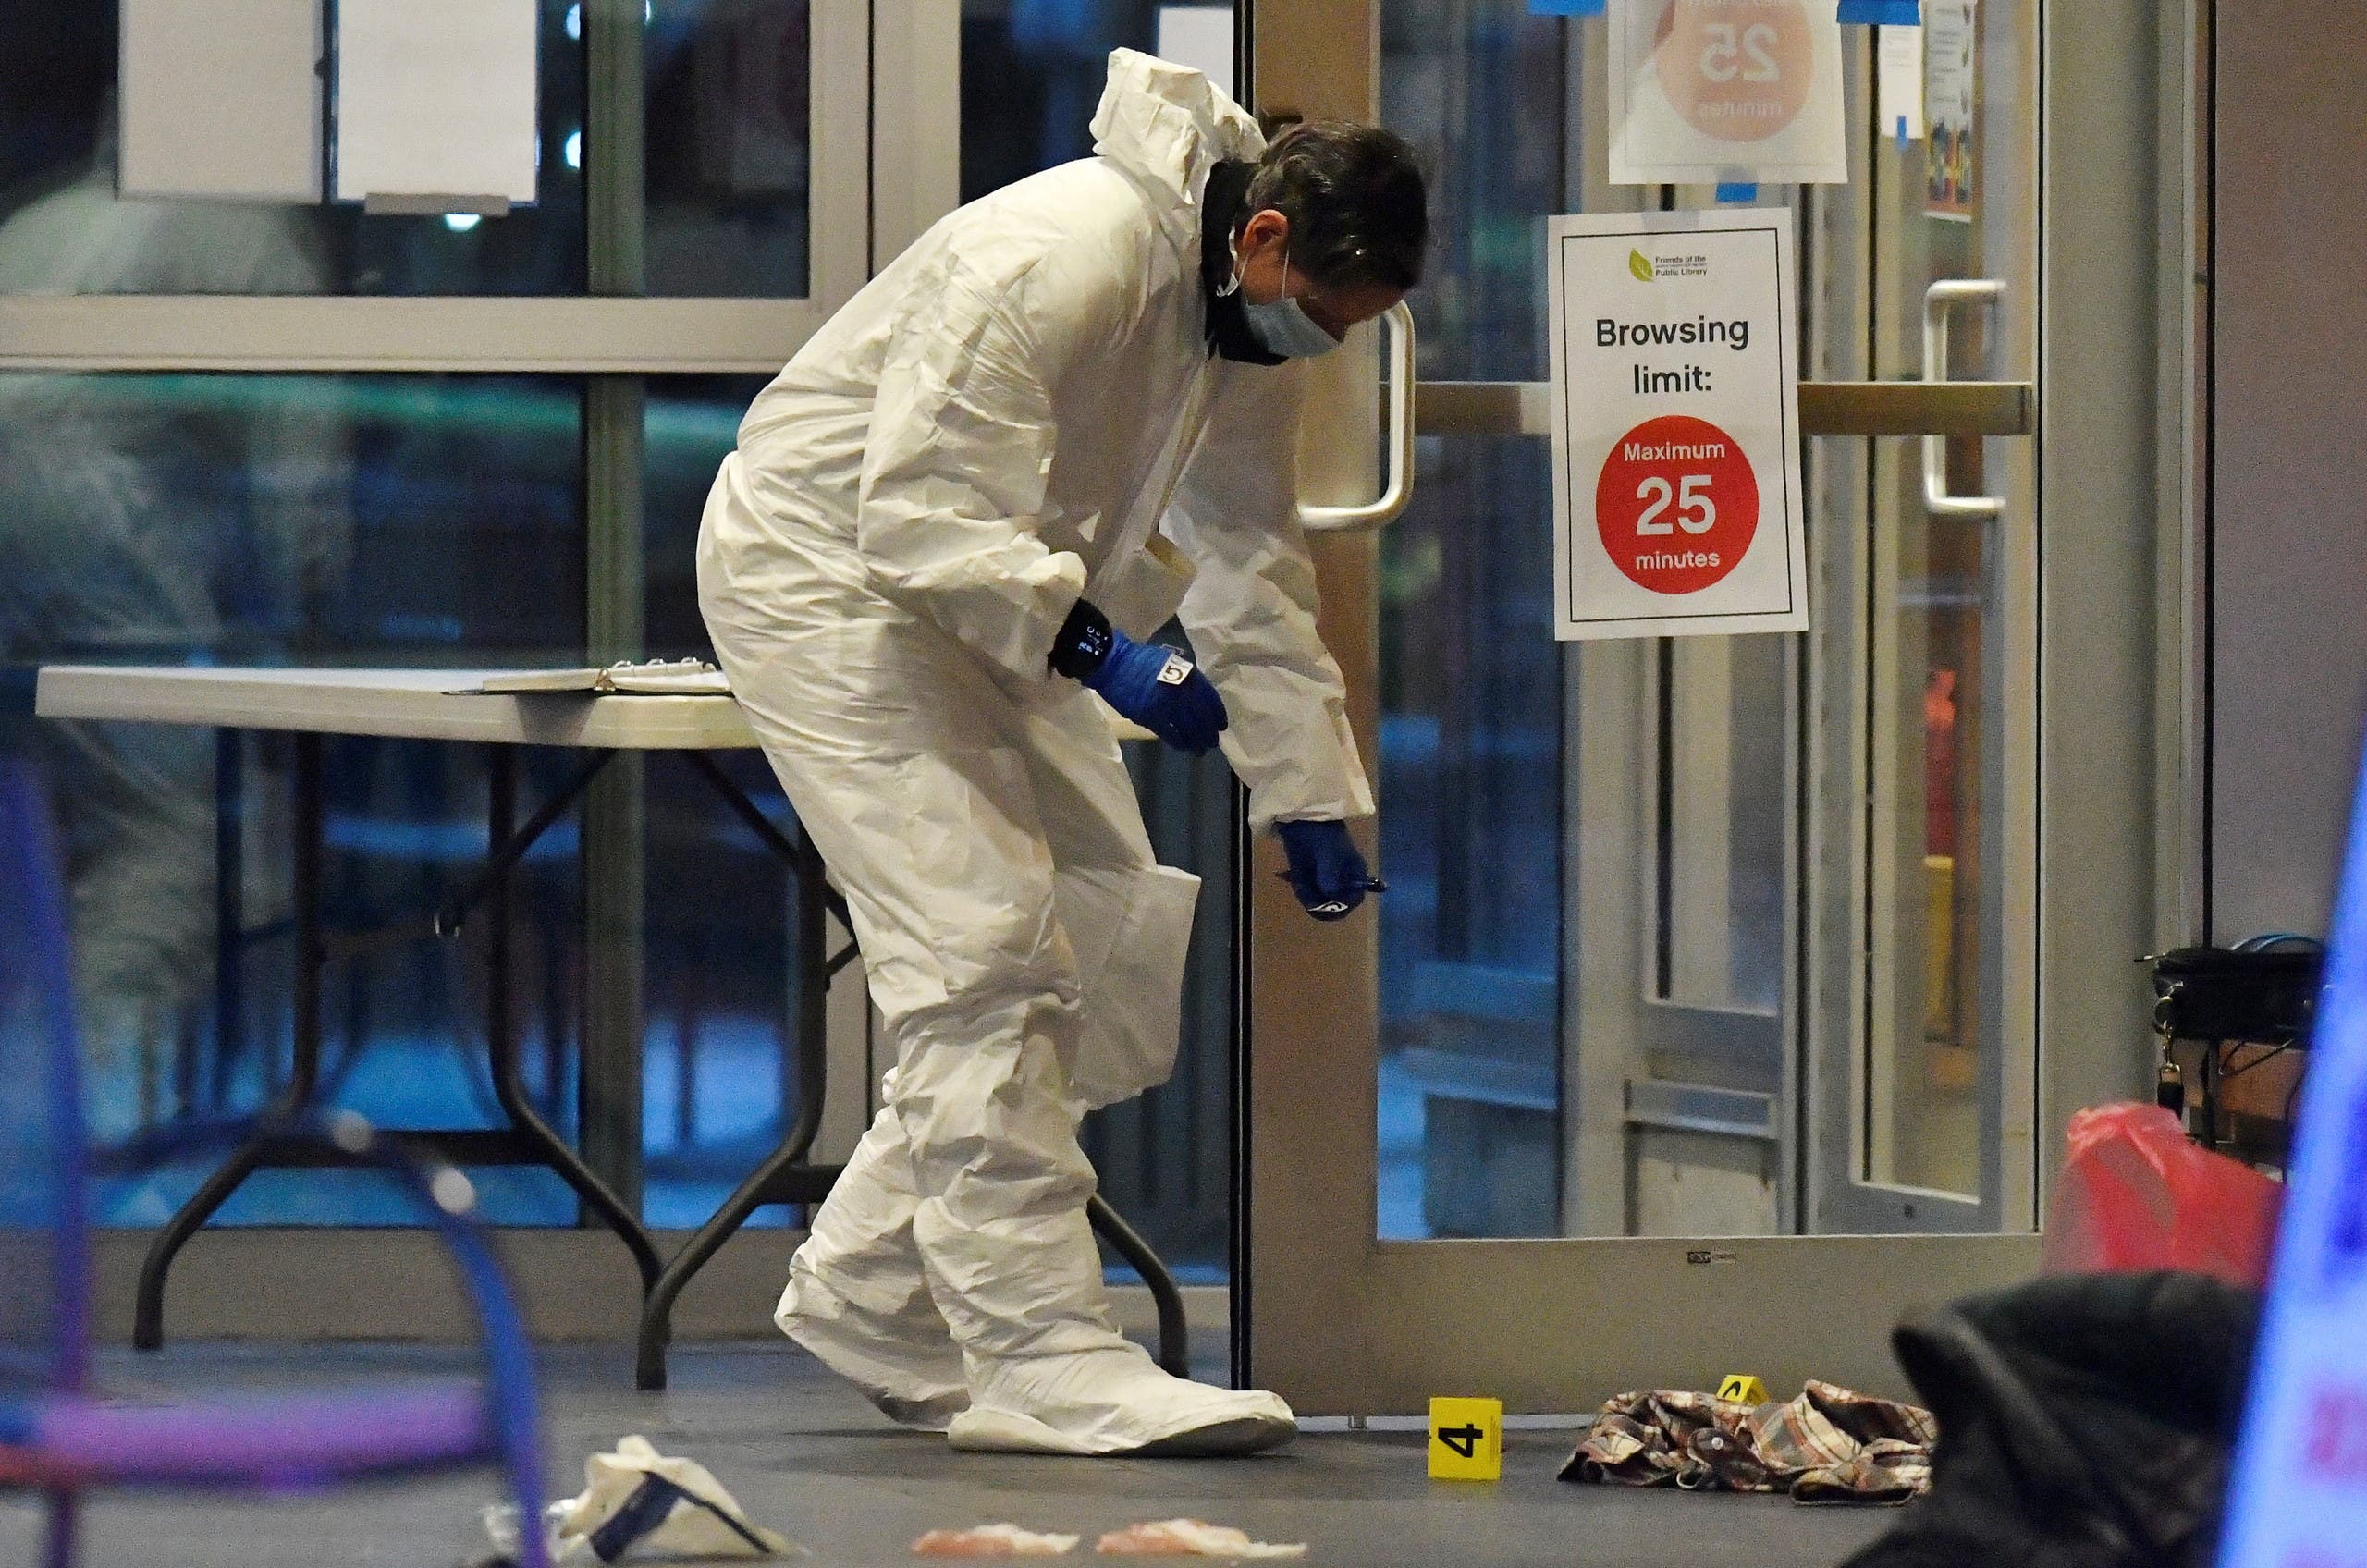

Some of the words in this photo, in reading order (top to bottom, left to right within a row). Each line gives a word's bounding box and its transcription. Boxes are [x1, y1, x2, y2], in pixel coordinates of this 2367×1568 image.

[1655, 268, 1679, 276] Public
[1681, 268, 1708, 276] Library
[1597, 315, 1748, 350] Browsing
[1634, 364, 1711, 394] limit:
[1624, 442, 1725, 461] Maximum
[1636, 474, 1716, 536] 25
[1635, 550, 1721, 570] minutes
[1438, 1423, 1484, 1458] 4
